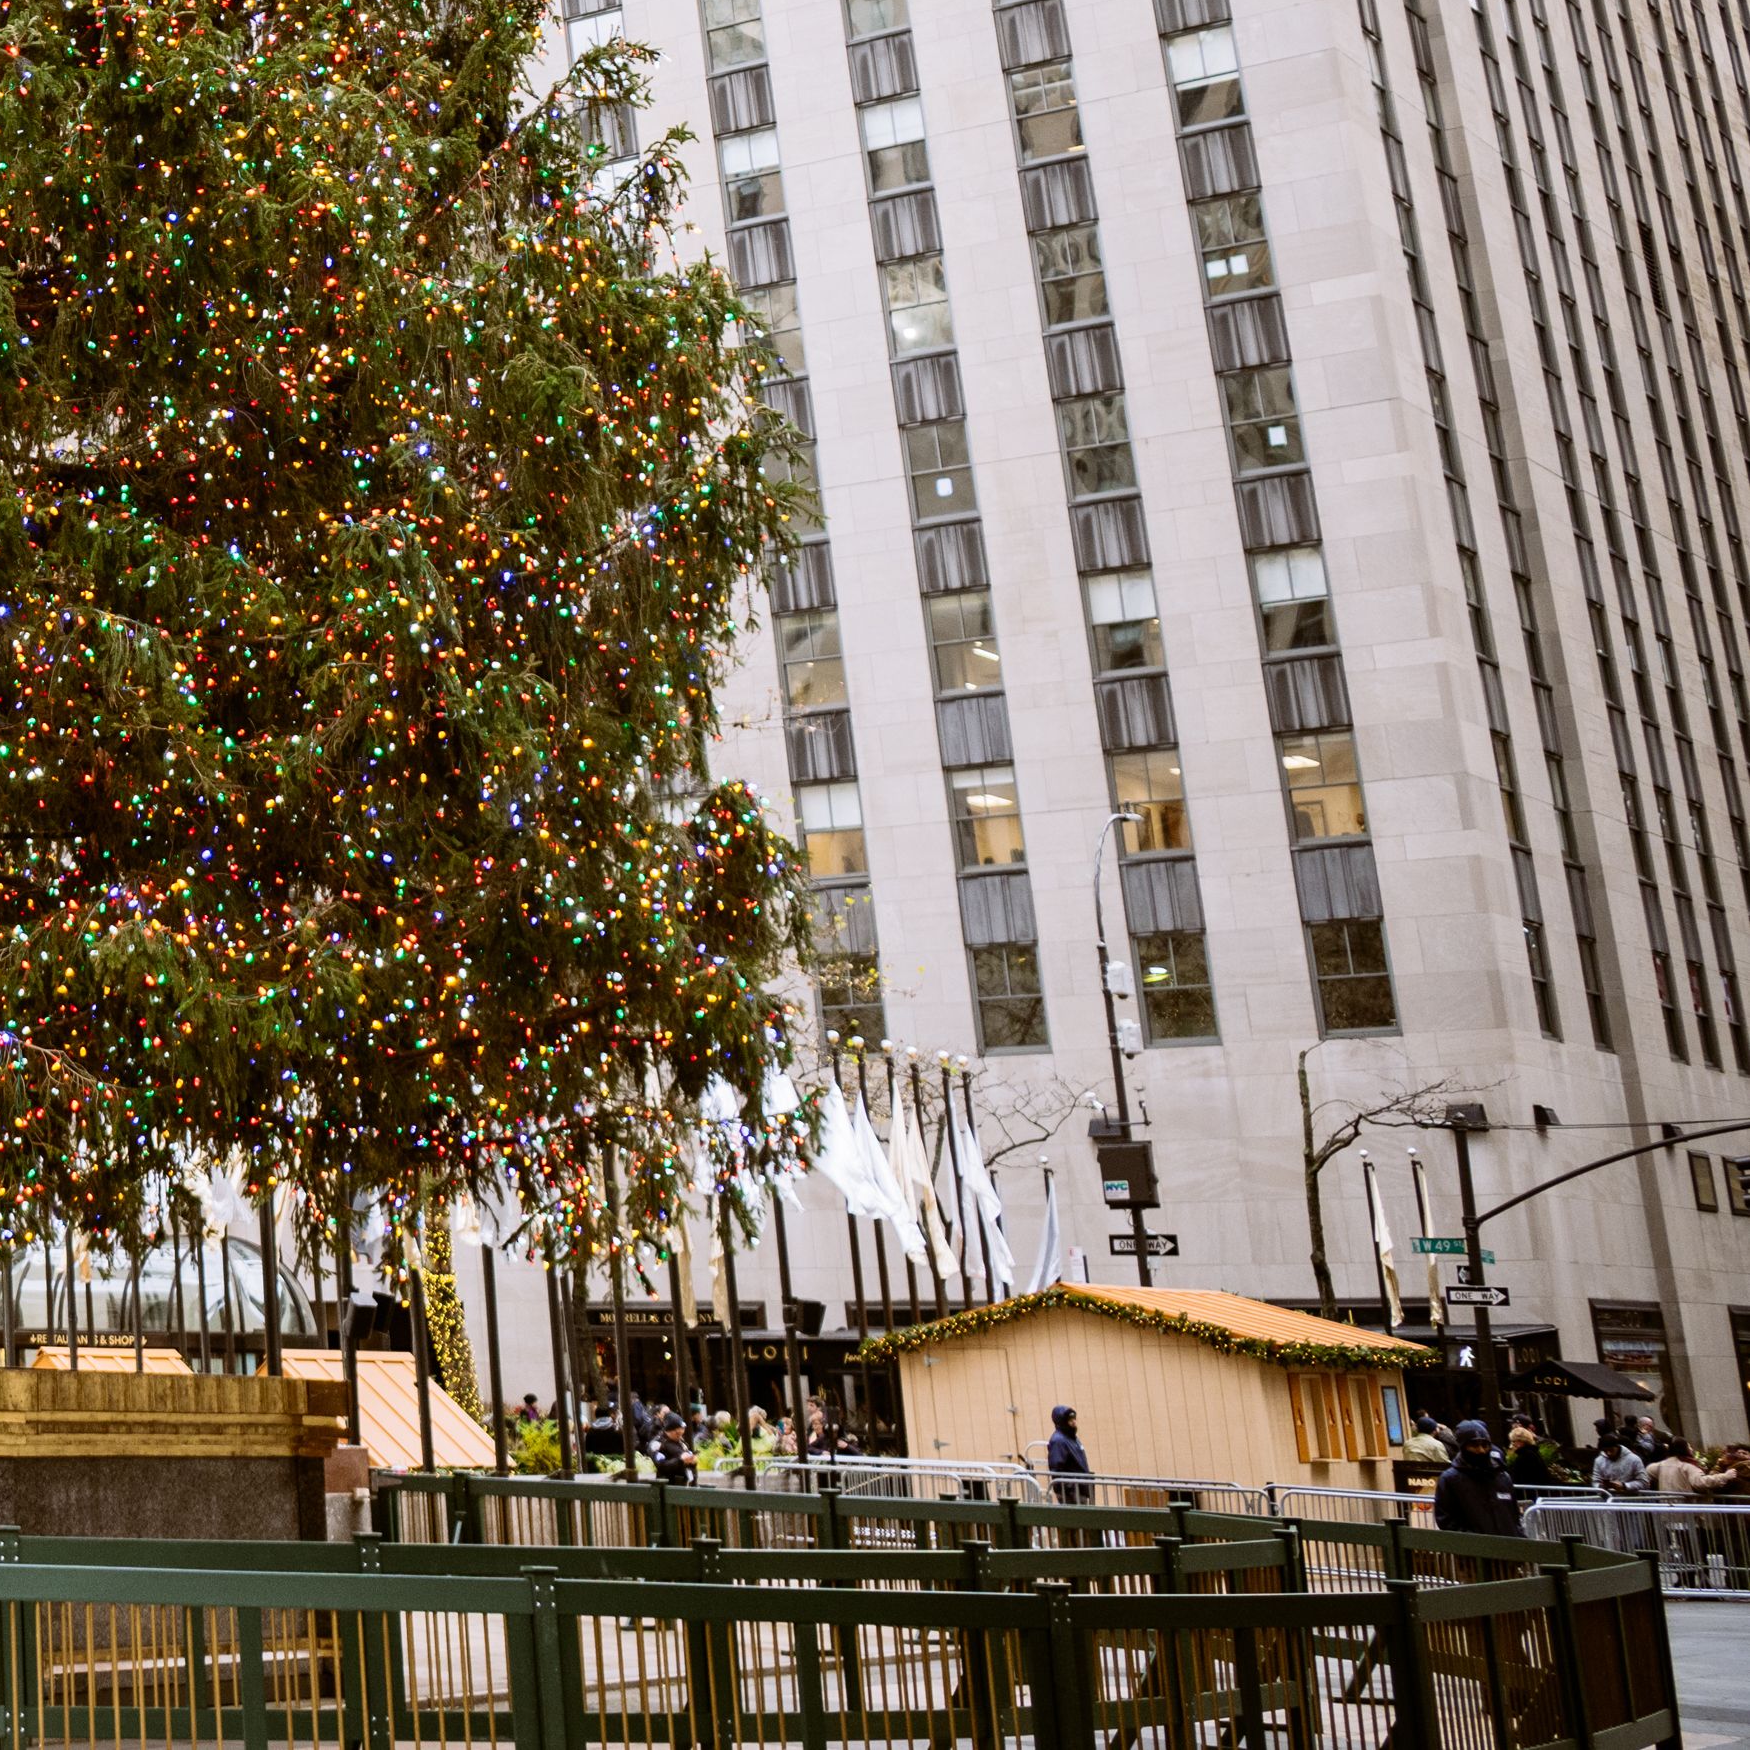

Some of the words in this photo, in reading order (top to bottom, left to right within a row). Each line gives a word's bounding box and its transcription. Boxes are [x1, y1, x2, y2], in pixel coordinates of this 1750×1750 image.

[1105, 1182, 1128, 1191] NYC
[1148, 1240, 1169, 1249] WAY
[1422, 1240, 1432, 1251] W
[1435, 1240, 1451, 1252] 49
[1454, 1292, 1473, 1300] ONE
[1481, 1292, 1500, 1301] WAY
[600, 1312, 650, 1323] MORELL
[100, 1334, 108, 1346] &
[108, 1334, 137, 1347] SHOP
[1534, 1375, 1568, 1387] LODI
[1407, 1477, 1436, 1488] NARO
